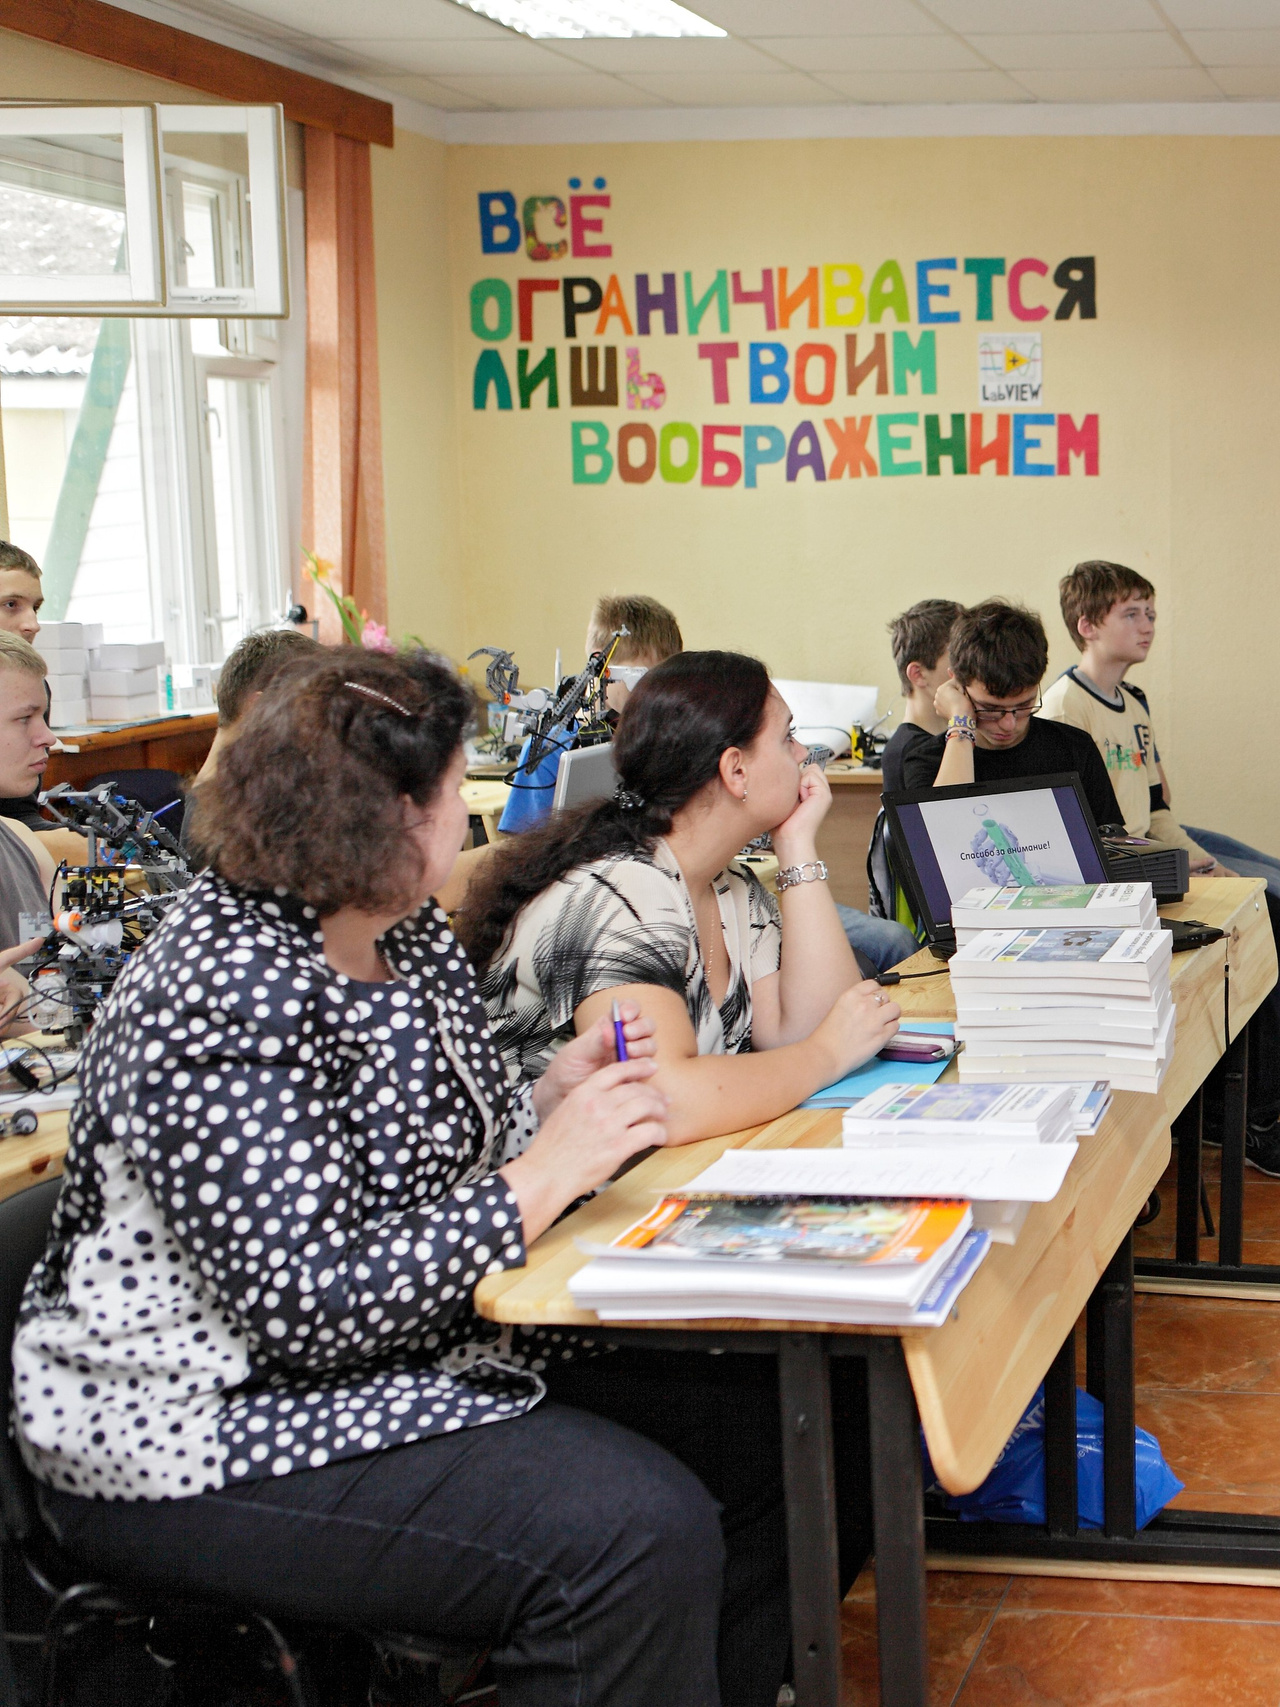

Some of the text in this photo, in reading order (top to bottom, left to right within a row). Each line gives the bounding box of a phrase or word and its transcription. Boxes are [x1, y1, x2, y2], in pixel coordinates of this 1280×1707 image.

[478, 176, 612, 262] ВСЁ
[469, 256, 1097, 342] ОГРАНИЧИВАЕТСЯ
[472, 330, 938, 411] ЛИШЬ ТВОИМ
[982, 383, 1042, 402] LabVIEW
[571, 412, 1100, 489] ВООБРАЖЕНИЕМ
[960, 841, 1051, 861] Спасибо за внимание!
